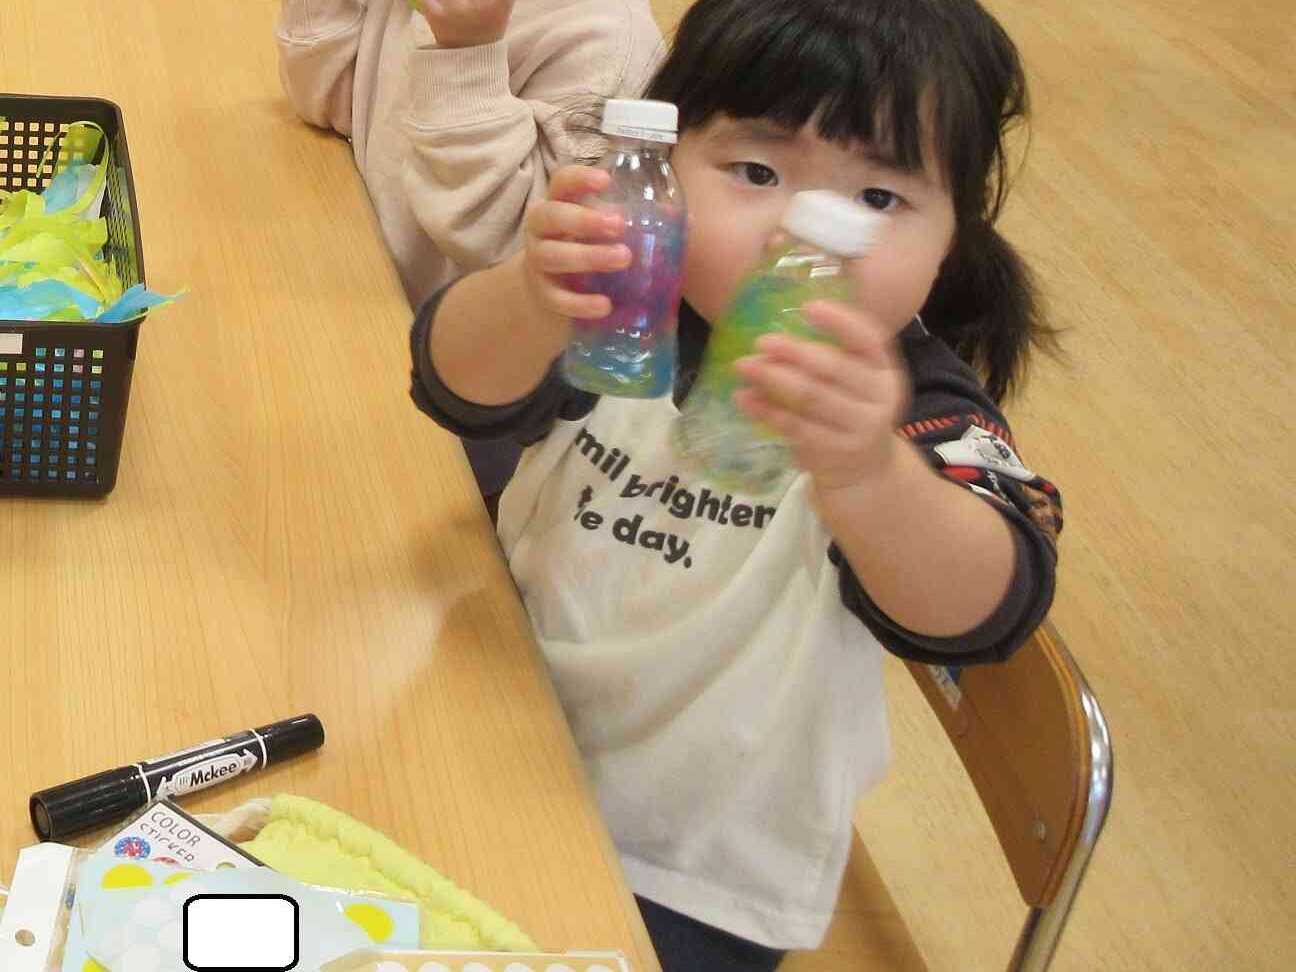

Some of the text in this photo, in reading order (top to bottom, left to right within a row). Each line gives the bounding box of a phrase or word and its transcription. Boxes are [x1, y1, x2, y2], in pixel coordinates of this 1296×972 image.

[612, 513, 693, 569] day.
[190, 762, 237, 787] Mckee
[151, 811, 201, 846] COLOR
